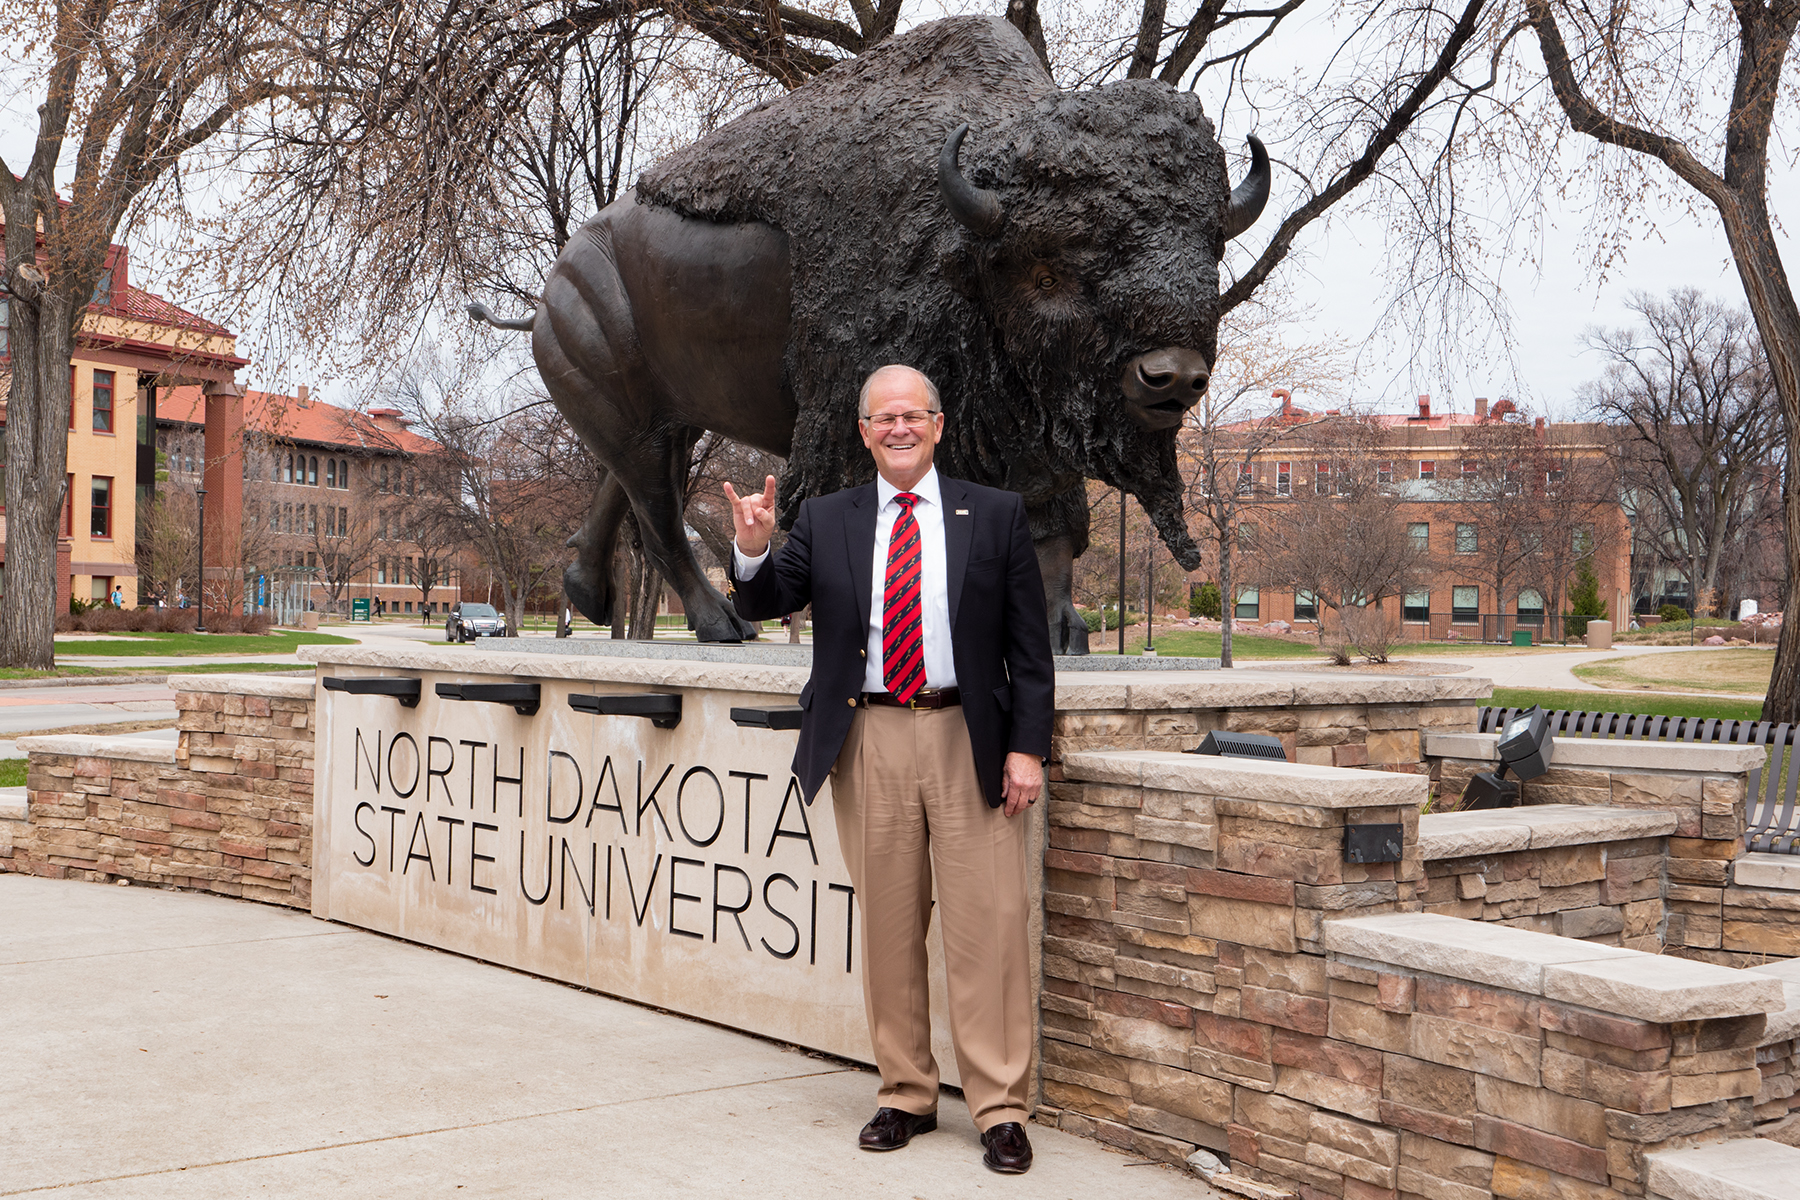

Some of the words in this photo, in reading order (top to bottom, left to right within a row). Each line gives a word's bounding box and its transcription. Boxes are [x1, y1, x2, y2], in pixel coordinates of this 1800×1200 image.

[355, 727, 524, 818] NORTH
[547, 750, 819, 866] DAKOTA
[353, 801, 499, 896] STATE
[519, 828, 856, 974] UNIVERSIT
